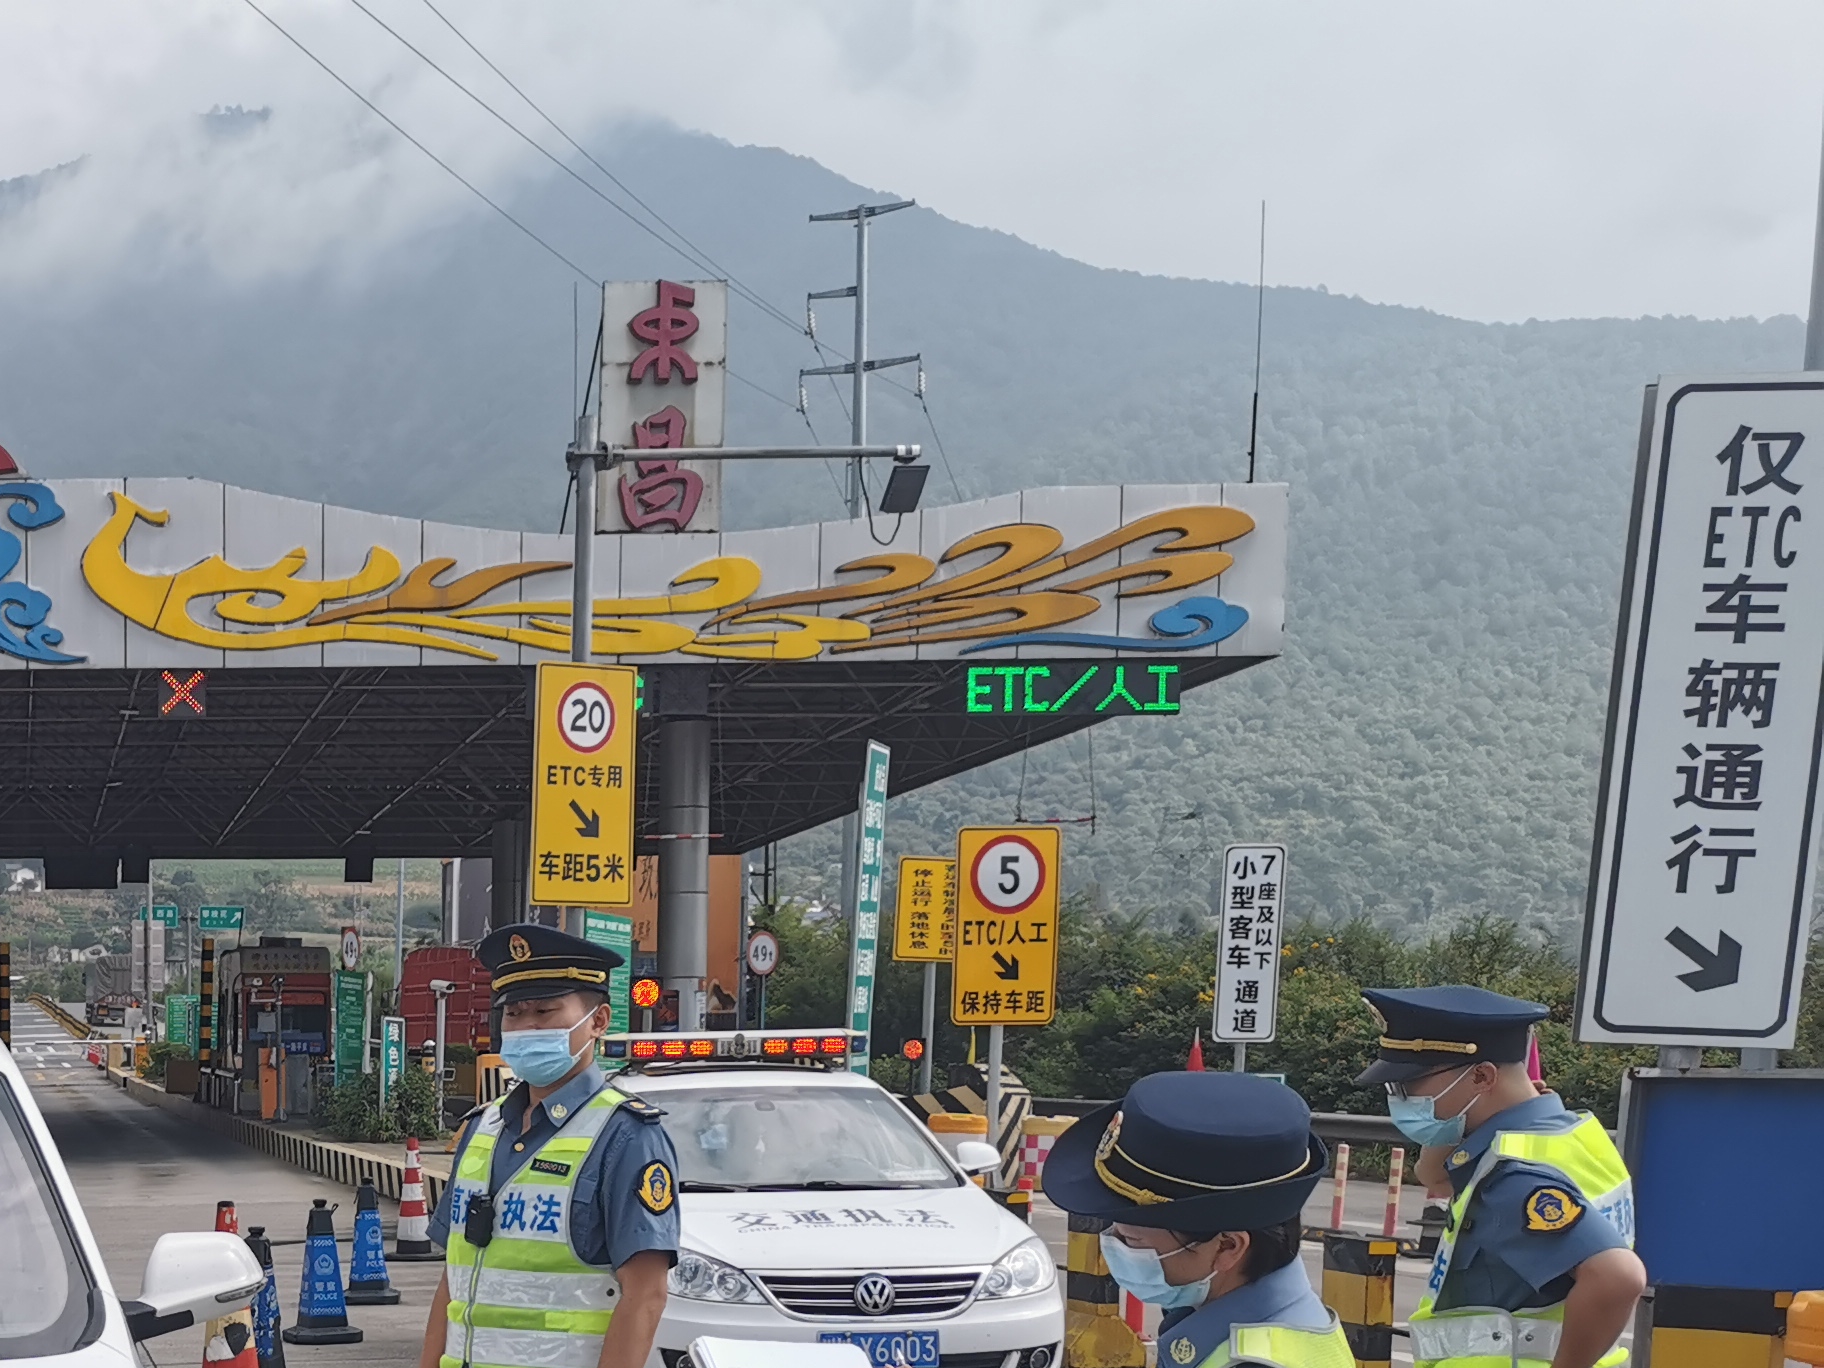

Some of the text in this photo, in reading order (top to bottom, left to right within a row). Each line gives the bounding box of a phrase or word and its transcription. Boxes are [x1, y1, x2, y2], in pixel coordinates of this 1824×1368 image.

[619, 404, 703, 531] 昌
[1666, 424, 1805, 895] 仅ETC车辆通行
[967, 665, 1180, 712] ETC/人工
[570, 698, 605, 733] 20
[547, 764, 623, 788] ETC专用
[539, 851, 624, 882] 车距5米
[998, 856, 1019, 894] 5
[1227, 856, 1257, 969] 小型客车
[1254, 855, 1277, 969] 7座及以下
[963, 920, 1048, 945] ETC/人工
[752, 945, 773, 961] 49t
[961, 990, 1045, 1015] 保持车距
[1233, 979, 1259, 1033] 通道
[500, 1192, 561, 1234] 执法
[726, 1209, 949, 1229] 交通执法
